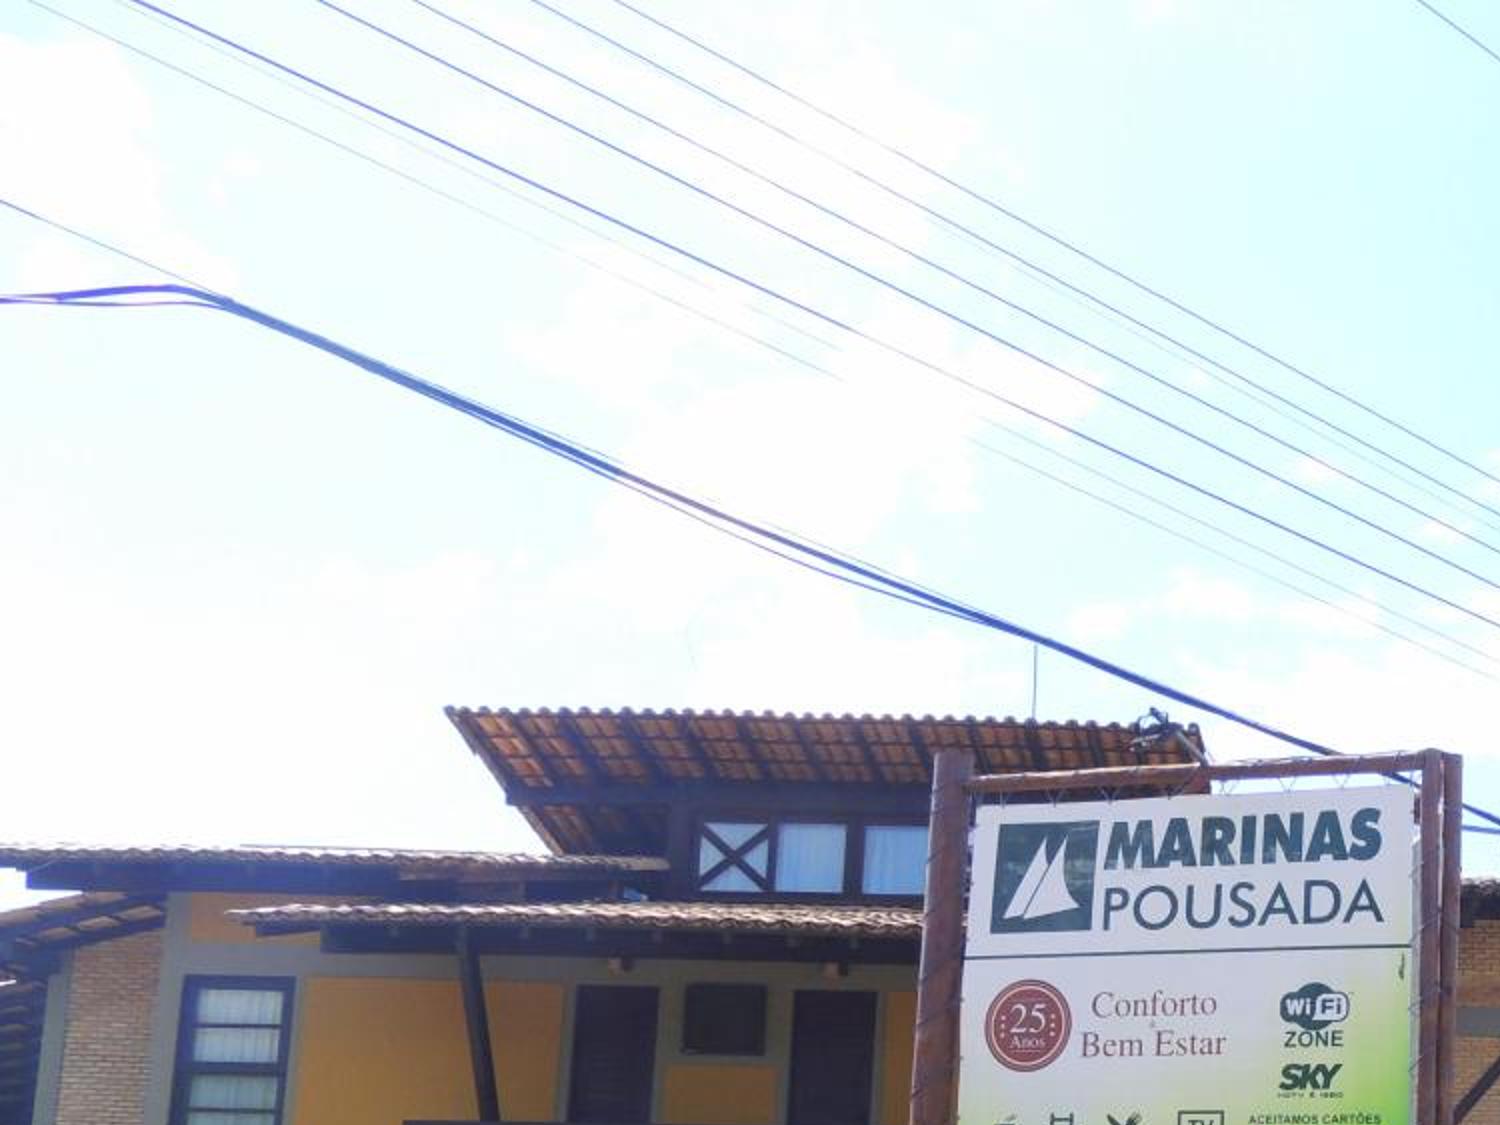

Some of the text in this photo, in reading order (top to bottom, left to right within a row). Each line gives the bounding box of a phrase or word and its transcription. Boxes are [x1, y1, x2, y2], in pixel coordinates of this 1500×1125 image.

[1103, 807, 1382, 870] MARINAS
[1103, 879, 1384, 931] POUSADA
[1009, 1003, 1047, 1033] 25
[1090, 990, 1218, 1018] Conforto
[1010, 1034, 1046, 1050] Anos
[1081, 1029, 1227, 1057] Bem Estar
[1284, 1030, 1345, 1048] ZONE
[1278, 1063, 1343, 1090] SKY
[1247, 1111, 1382, 1125] ACEITAMOS CARTÕES
